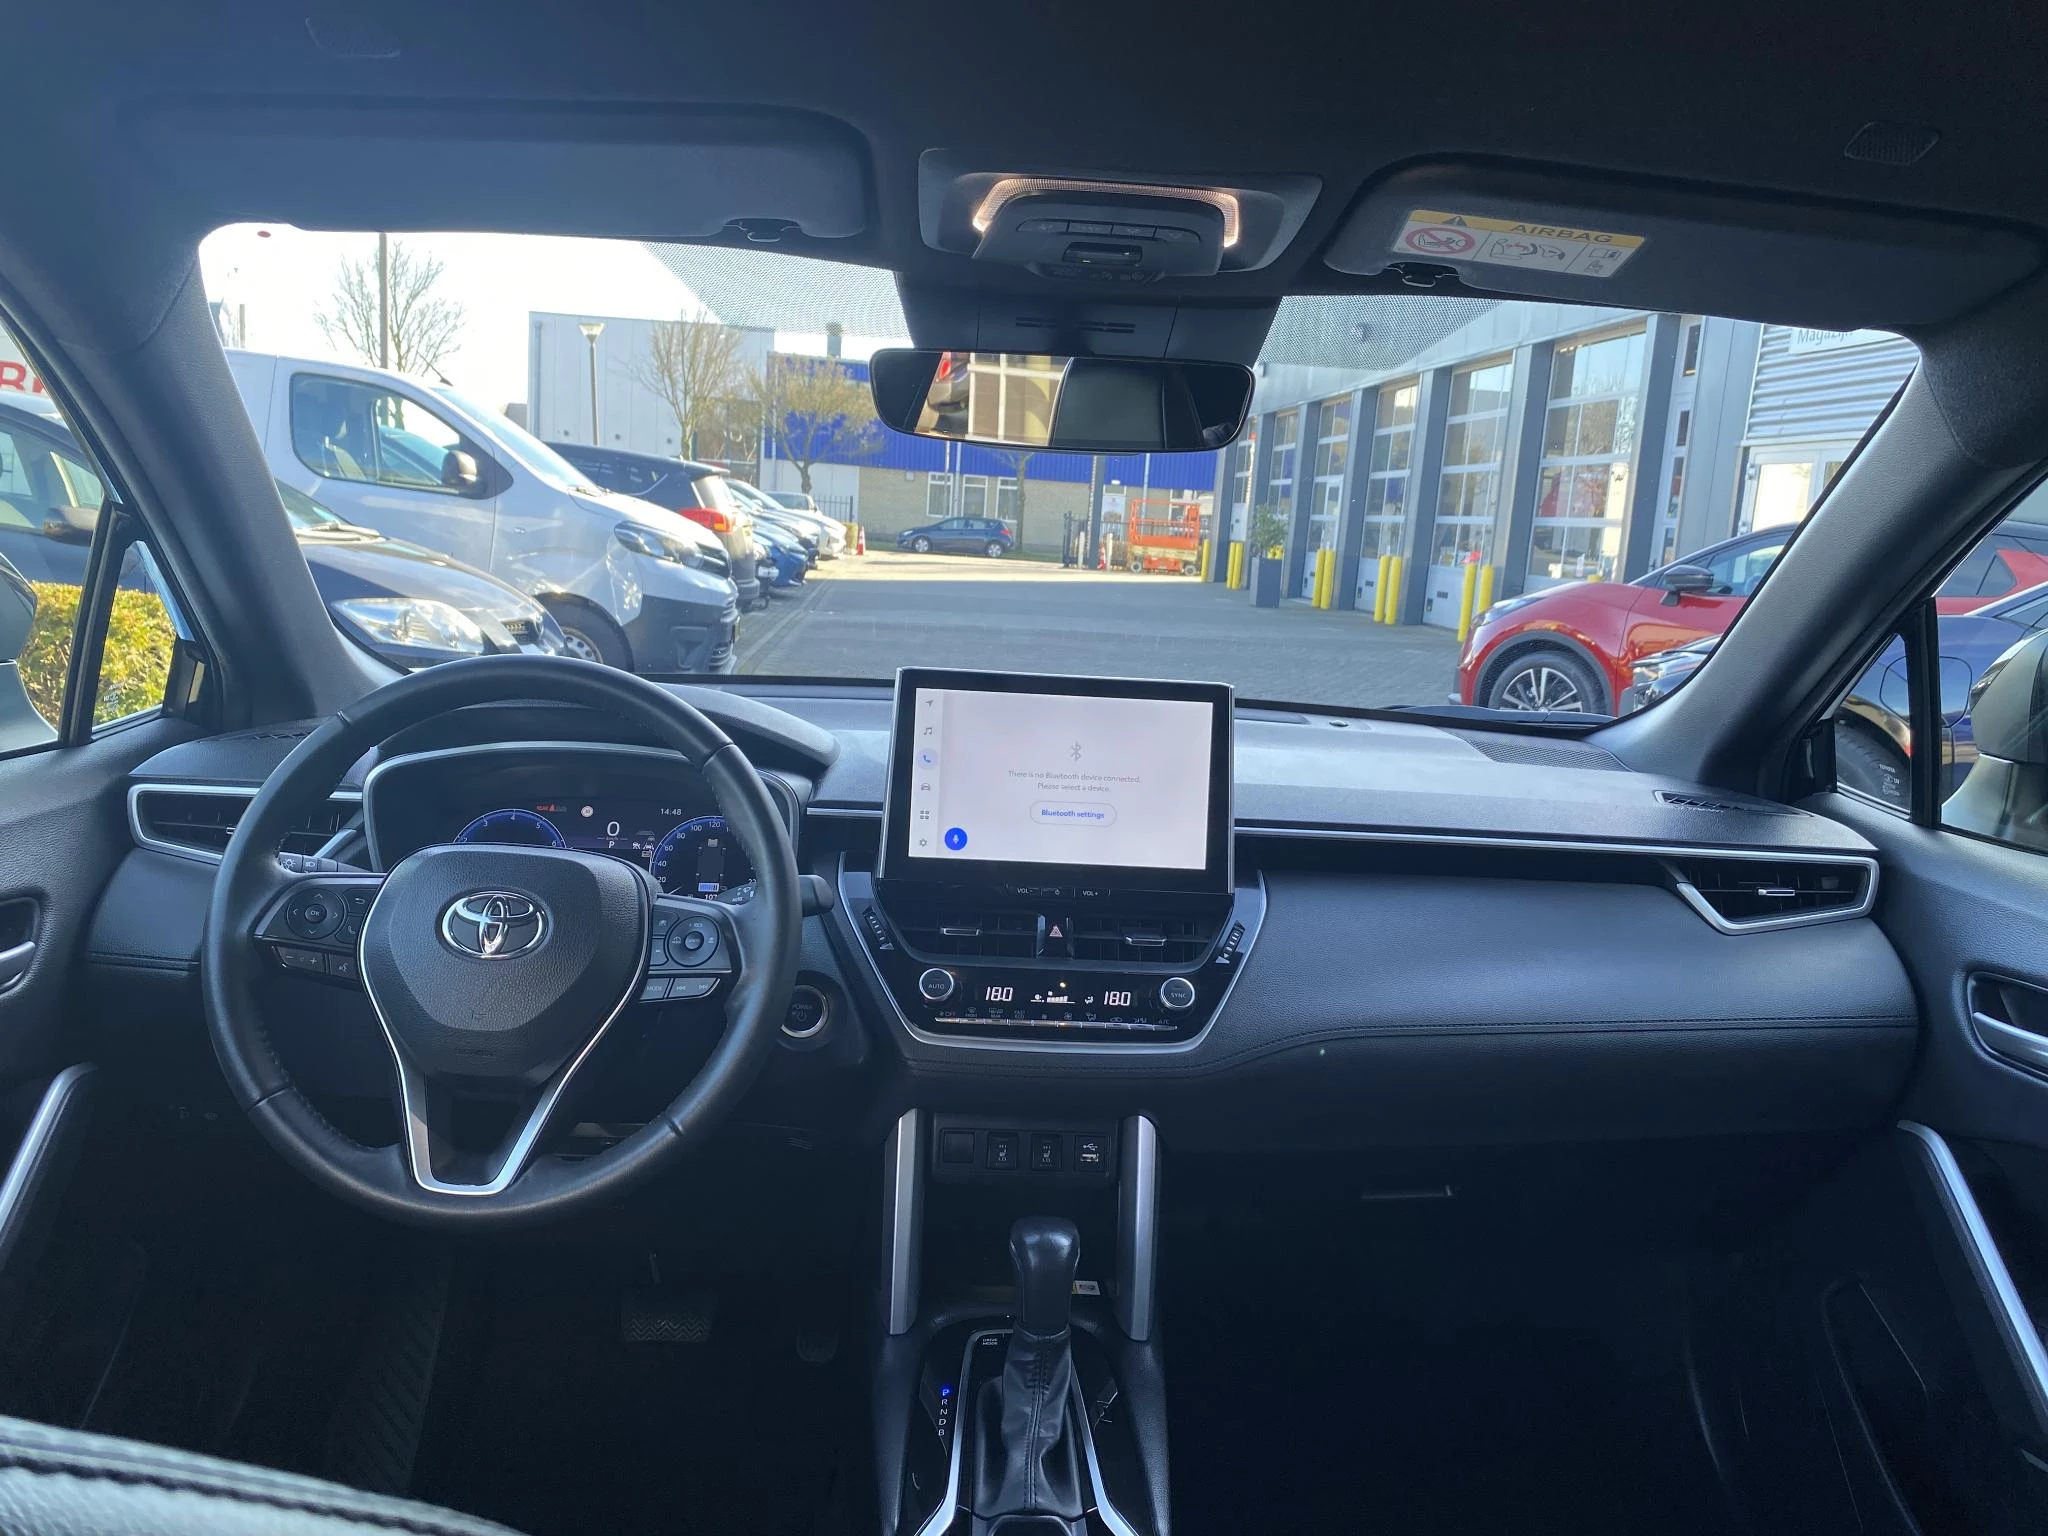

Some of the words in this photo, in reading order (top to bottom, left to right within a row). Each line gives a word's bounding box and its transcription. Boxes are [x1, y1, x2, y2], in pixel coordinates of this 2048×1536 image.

[1510, 224, 1613, 243] AIRBAG
[1008, 770, 1027, 778] There
[1028, 771, 1034, 779] is
[1046, 772, 1080, 781] Bluetooth
[1081, 773, 1102, 782] device
[1037, 782, 1059, 790] Please
[1061, 783, 1081, 791] select
[660, 808, 682, 816] 14:48
[1041, 808, 1075, 818] Bluetooth
[1076, 810, 1105, 820] settings
[606, 821, 620, 836] 0
[608, 840, 615, 848] P
[942, 1388, 950, 1396] P
[940, 1408, 948, 1416] N
[938, 1418, 946, 1426] D
